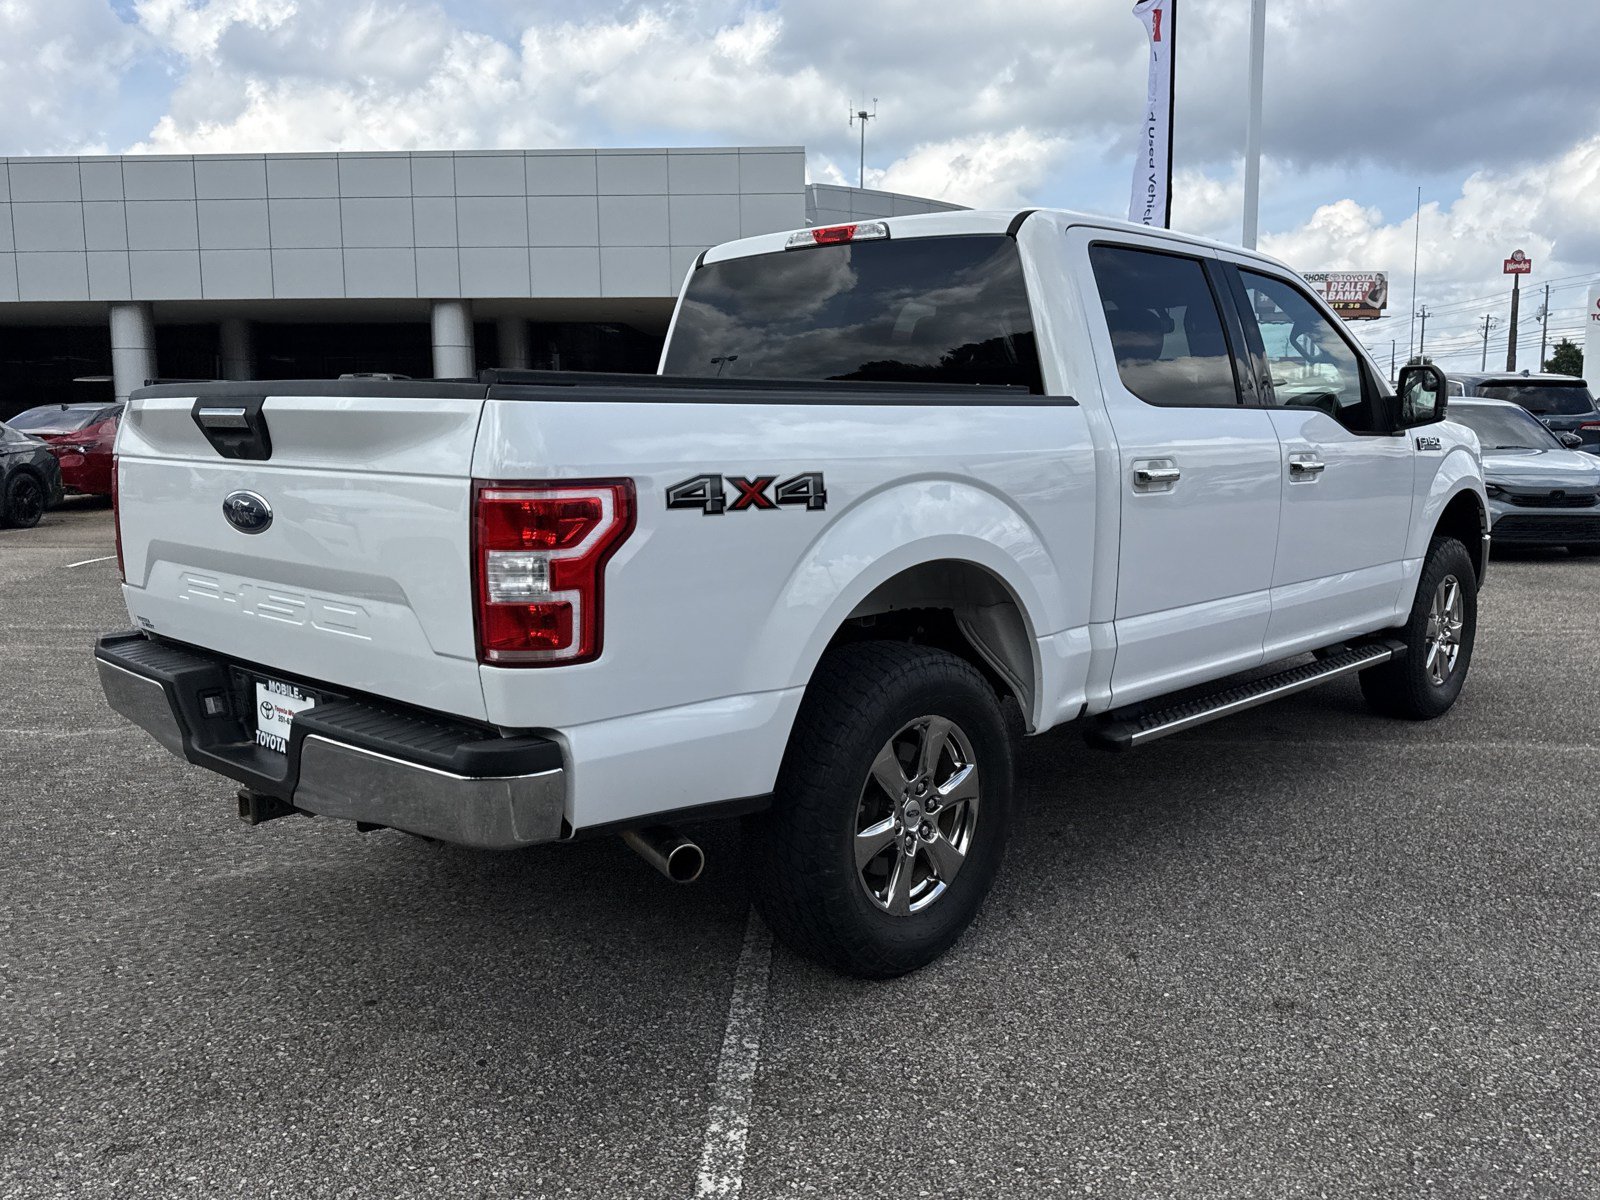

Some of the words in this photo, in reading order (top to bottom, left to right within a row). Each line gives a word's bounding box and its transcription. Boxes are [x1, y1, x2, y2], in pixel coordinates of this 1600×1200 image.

[1148, 126, 1156, 168] Used
[1303, 273, 1330, 281] SHORE
[1331, 282, 1370, 292] DEALER
[268, 680, 299, 700] MOBILE
[256, 729, 286, 754] TOYOTA
